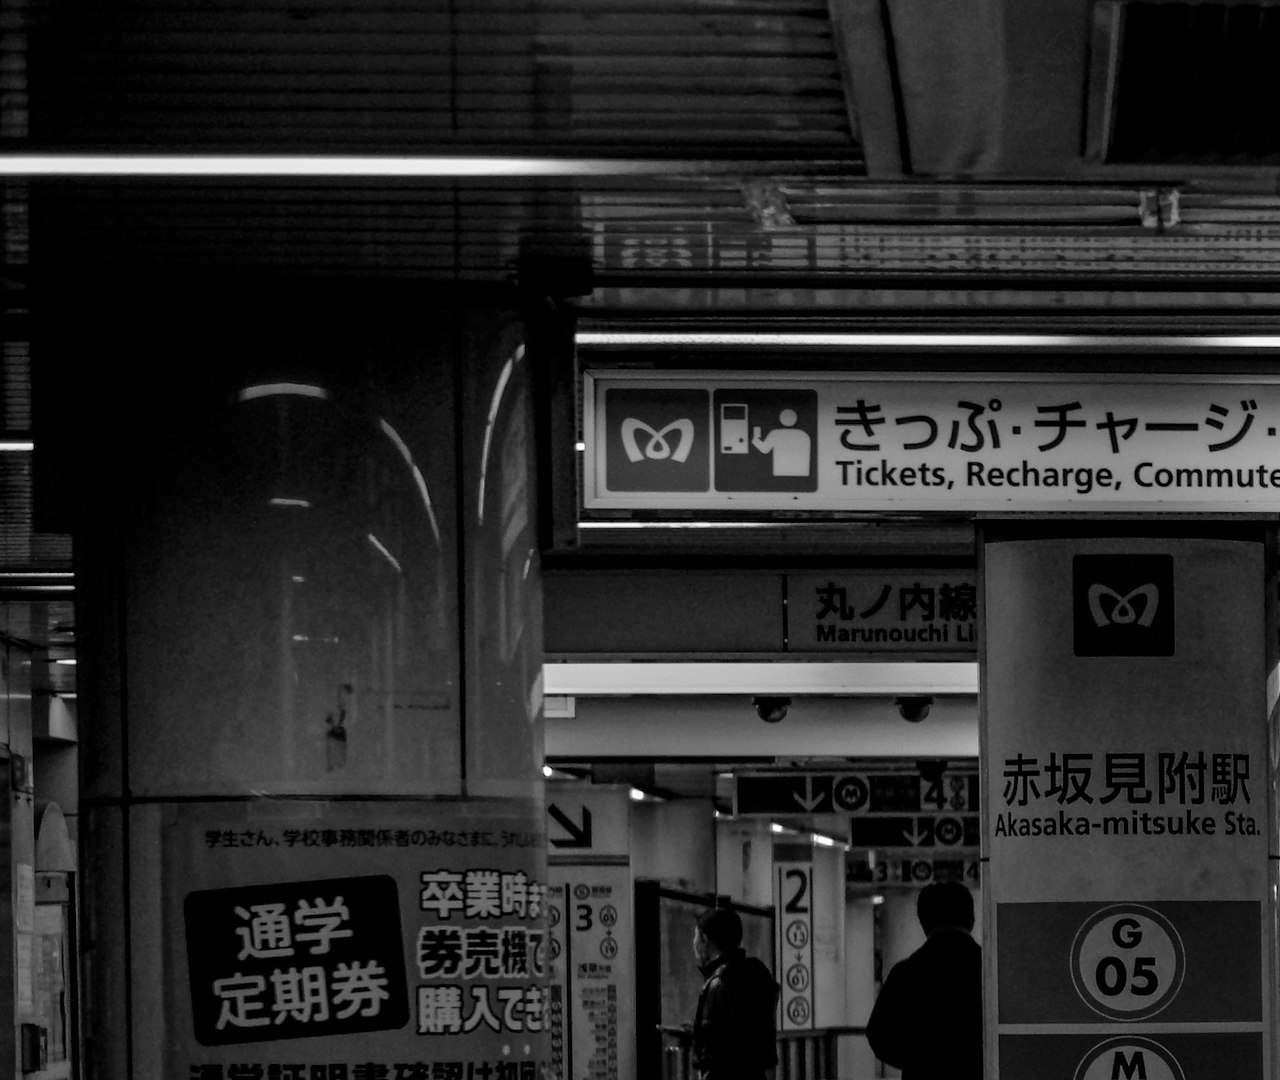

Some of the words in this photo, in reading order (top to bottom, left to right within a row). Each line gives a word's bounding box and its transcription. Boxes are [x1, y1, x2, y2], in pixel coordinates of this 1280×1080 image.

[835, 460, 955, 490] Tickets,
[966, 460, 1122, 494] Recharge,
[815, 583, 978, 621] 丸ノ内線
[816, 623, 949, 643] Marunouchi
[1002, 751, 1251, 806] 赤坂見附駅
[995, 809, 1217, 837] Akasaka-mitsuke
[1224, 811, 1261, 837] Sta.
[785, 869, 809, 914] 2
[234, 896, 354, 961] 通学
[576, 904, 593, 931] 3
[1112, 918, 1142, 949] G
[211, 960, 391, 1030] 定期券
[1095, 956, 1159, 996] 05
[416, 984, 548, 1035] 購入でき
[1111, 1051, 1147, 1080] M
